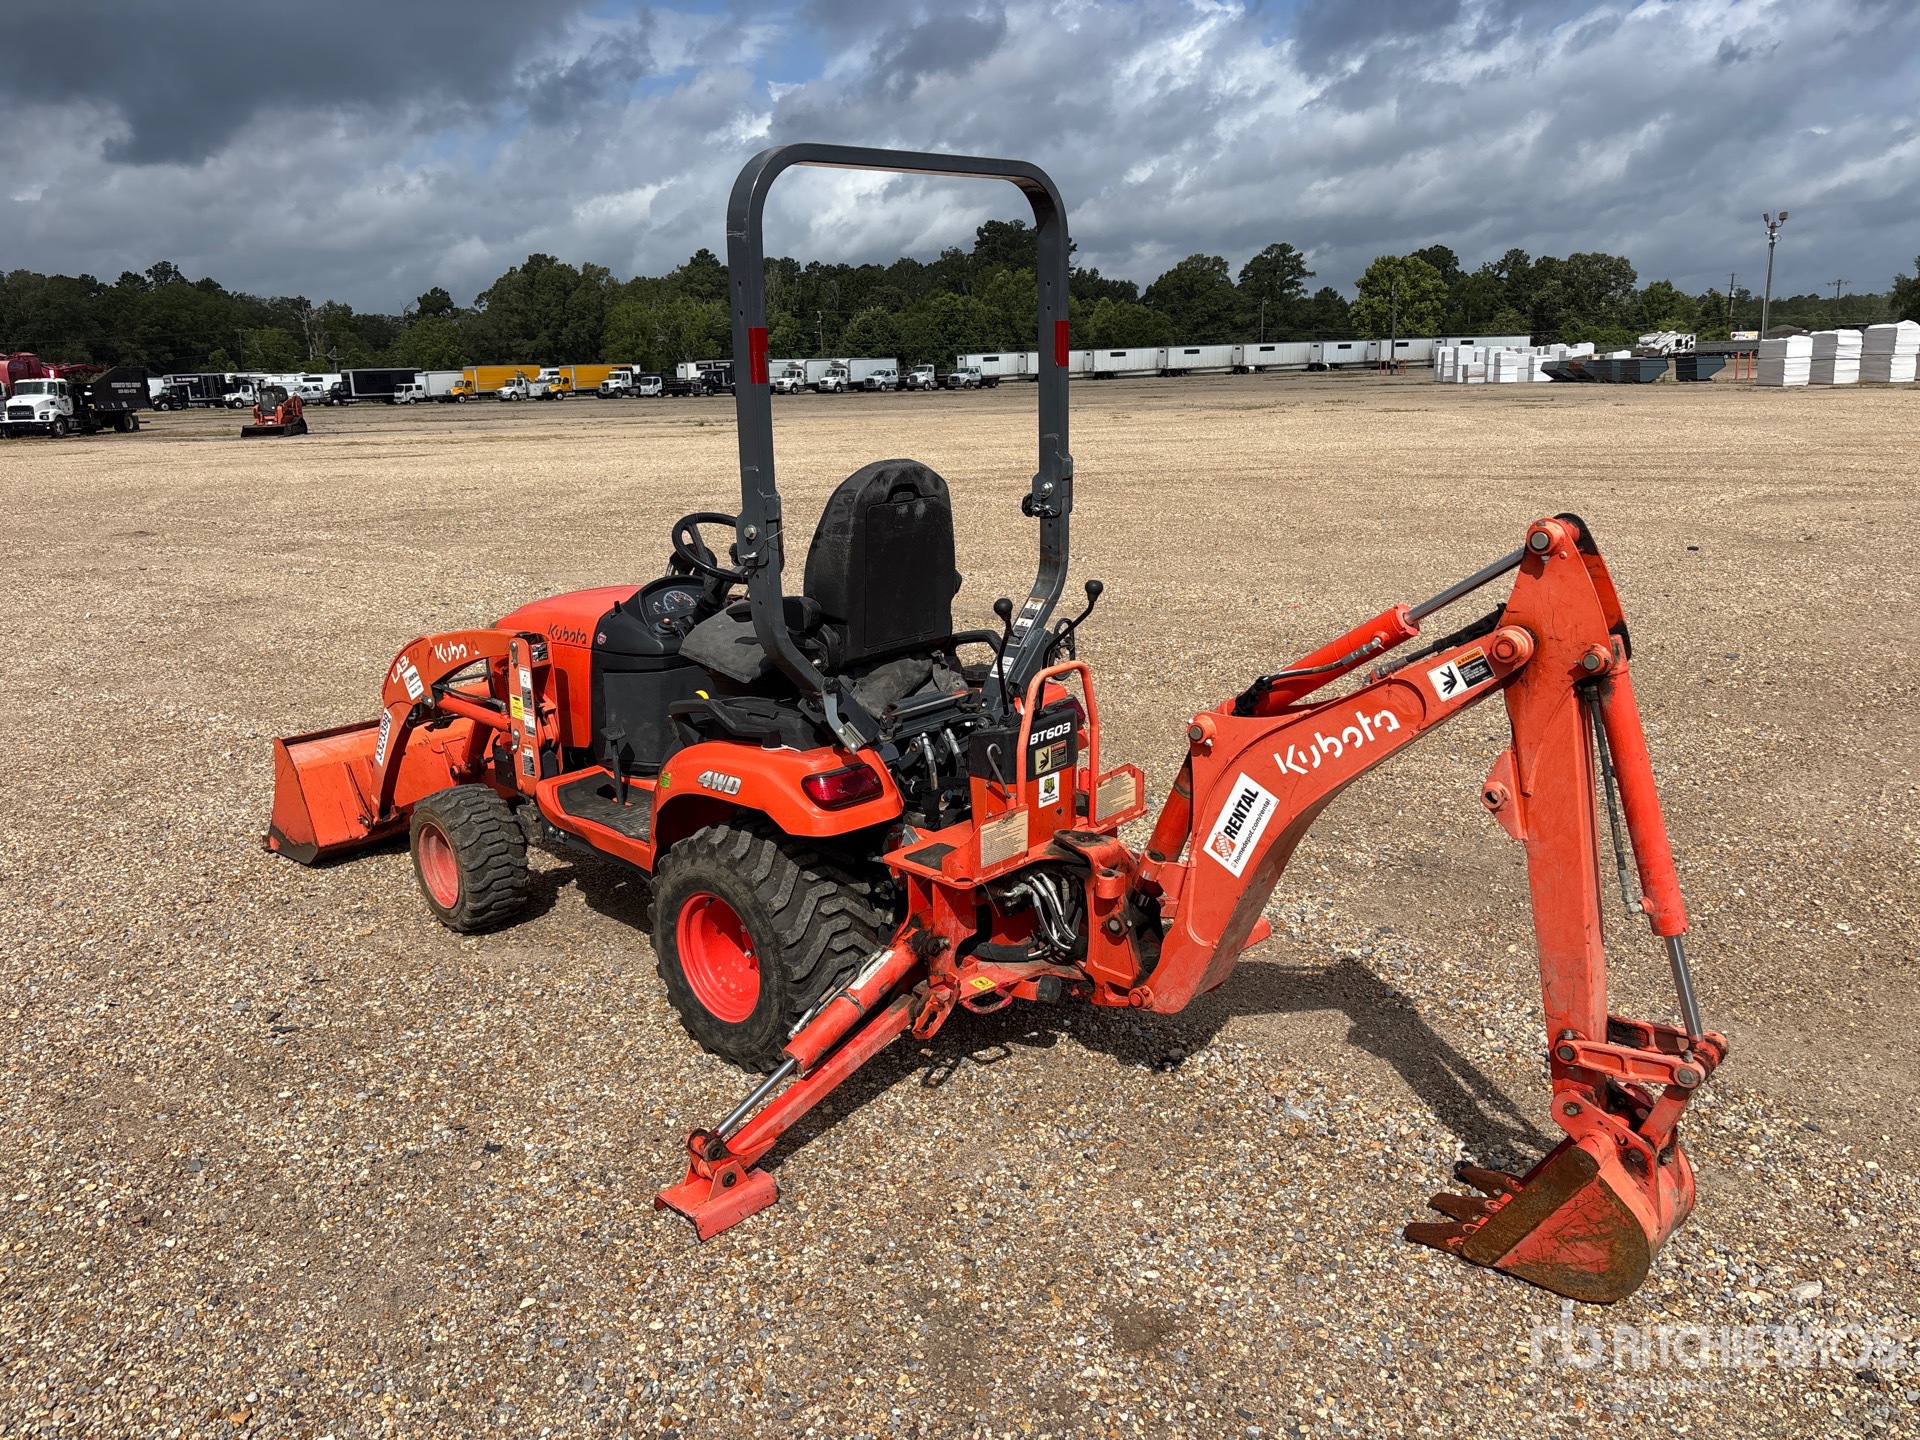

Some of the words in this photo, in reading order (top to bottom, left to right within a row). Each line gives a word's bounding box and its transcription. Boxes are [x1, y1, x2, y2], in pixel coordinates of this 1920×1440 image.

[548, 622, 587, 644] Kubota
[1029, 722, 1071, 746] BT603
[1273, 710, 1401, 775] Kubota
[697, 770, 742, 796] 4WD
[1223, 787, 1259, 840] RENTAL
[1233, 798, 1271, 864] homedepot.com/rental
